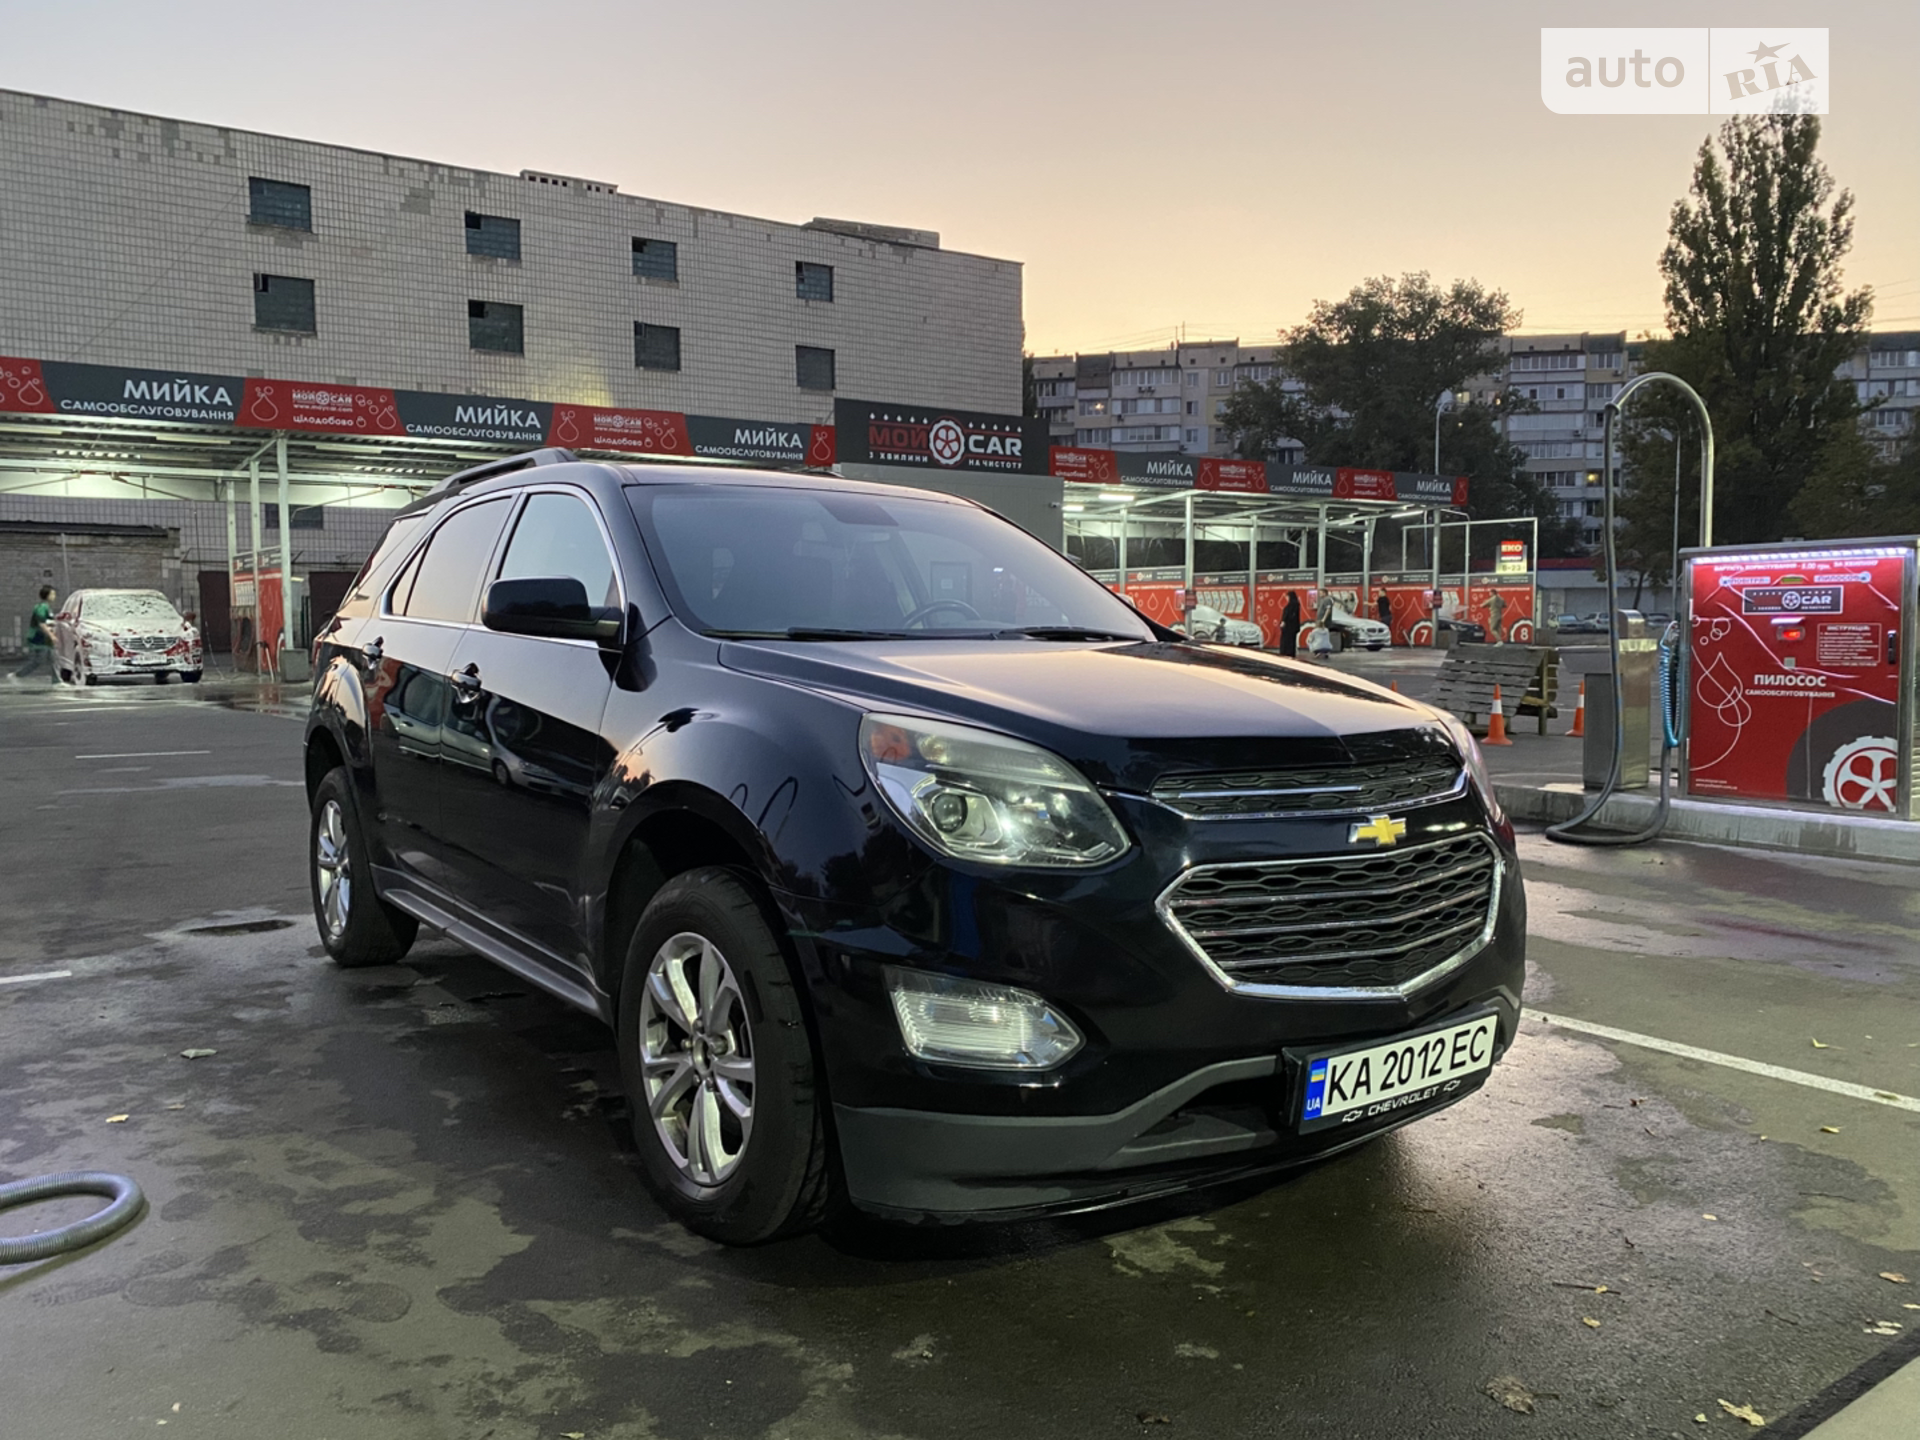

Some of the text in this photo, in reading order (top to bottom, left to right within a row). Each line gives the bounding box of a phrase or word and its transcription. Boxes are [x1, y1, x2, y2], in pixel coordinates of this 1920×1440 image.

[123, 379, 233, 406] МИЙКА
[60, 399, 234, 421] САМООБСЛУГОВУВАННЯ
[455, 404, 541, 428] МИЙКА
[406, 423, 542, 441] САМООБСЛУГОВУВАННЯ
[734, 427, 803, 449] МИЙКА
[869, 425, 1022, 456] МОЙ CAR
[695, 444, 803, 460] САМООБСЛУГОВУВАННЯ
[880, 453, 928, 462] ХВИЛИНИ
[982, 460, 1022, 469] ЧИСТОТУ
[1146, 460, 1193, 477] МИЙКА
[1292, 470, 1332, 486] МИЙКА
[1416, 479, 1451, 494] МИЙКА
[1801, 595, 1831, 605] CAR
[1420, 629, 1428, 643] 7
[1520, 628, 1529, 640] 8
[1754, 674, 1827, 687] ПИЛОСОС
[1327, 1025, 1488, 1106] KA 2012 EC
[1306, 1097, 1321, 1112] UA
[1367, 1085, 1440, 1116] CHEVROLET
